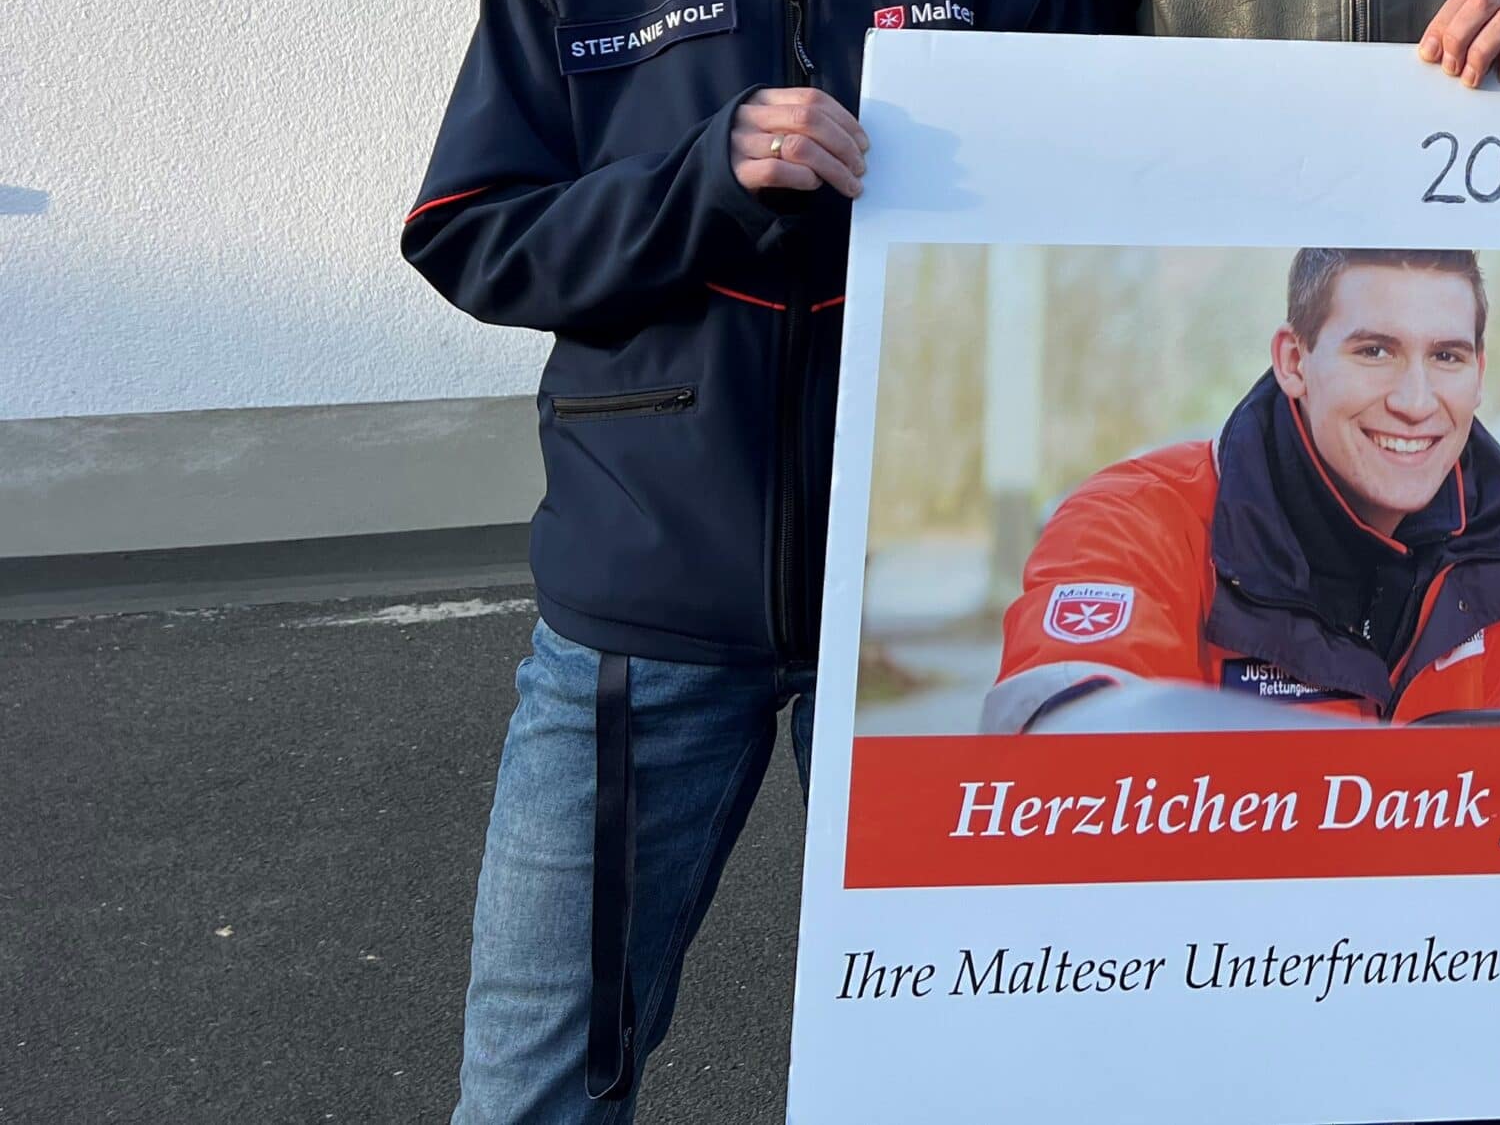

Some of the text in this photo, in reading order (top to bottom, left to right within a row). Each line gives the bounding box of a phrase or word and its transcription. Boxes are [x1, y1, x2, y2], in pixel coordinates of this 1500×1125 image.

[571, 3, 725, 57] STEFANIE WOLF
[911, 0, 975, 26] Malte
[1059, 588, 1126, 600] Malteser
[949, 775, 1299, 839] Herzlichen
[1317, 770, 1492, 831] Dank
[836, 935, 1500, 1002] Ihre Malteser Unterfranken
